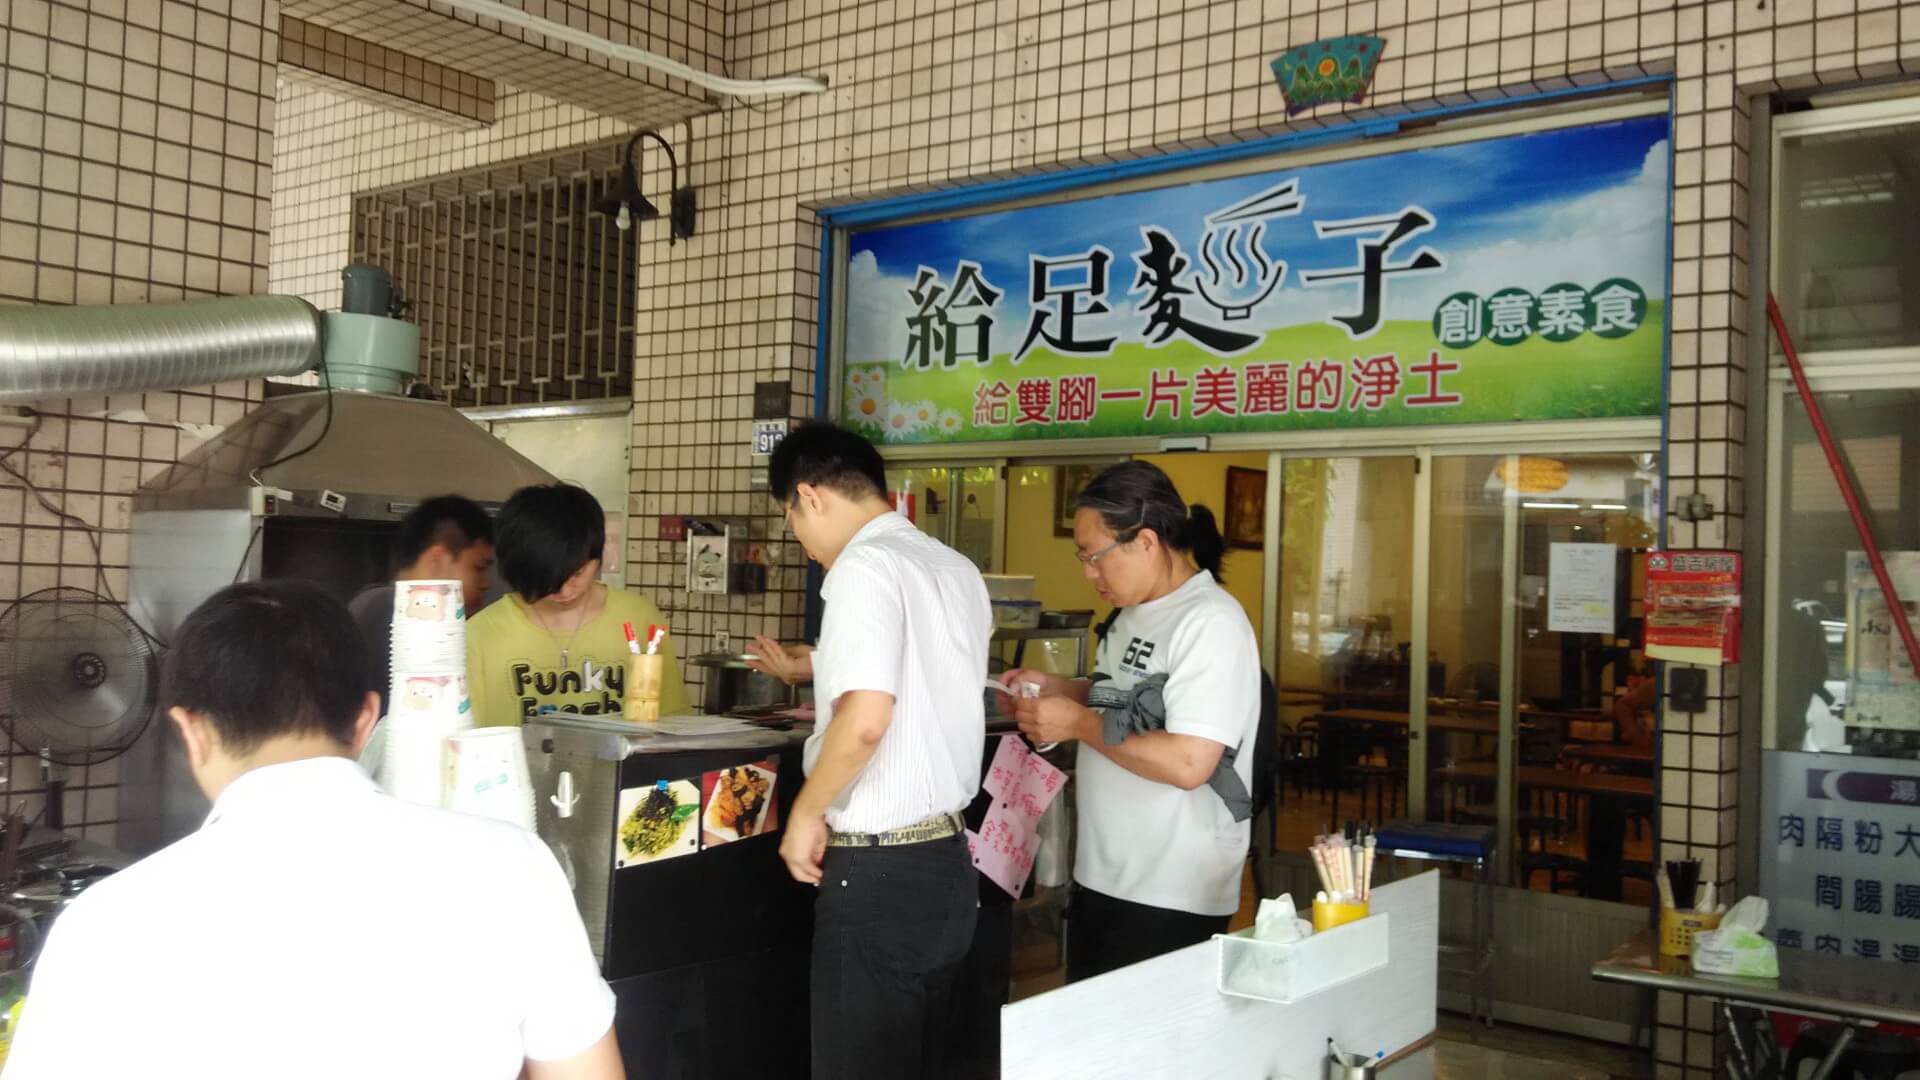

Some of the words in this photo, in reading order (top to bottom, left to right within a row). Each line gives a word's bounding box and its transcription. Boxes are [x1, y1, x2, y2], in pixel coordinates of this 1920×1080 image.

[1439, 284, 1640, 343] 創意素食
[975, 352, 1459, 425] 給雙腳一片美麗的淨土
[512, 660, 624, 698] Funky
